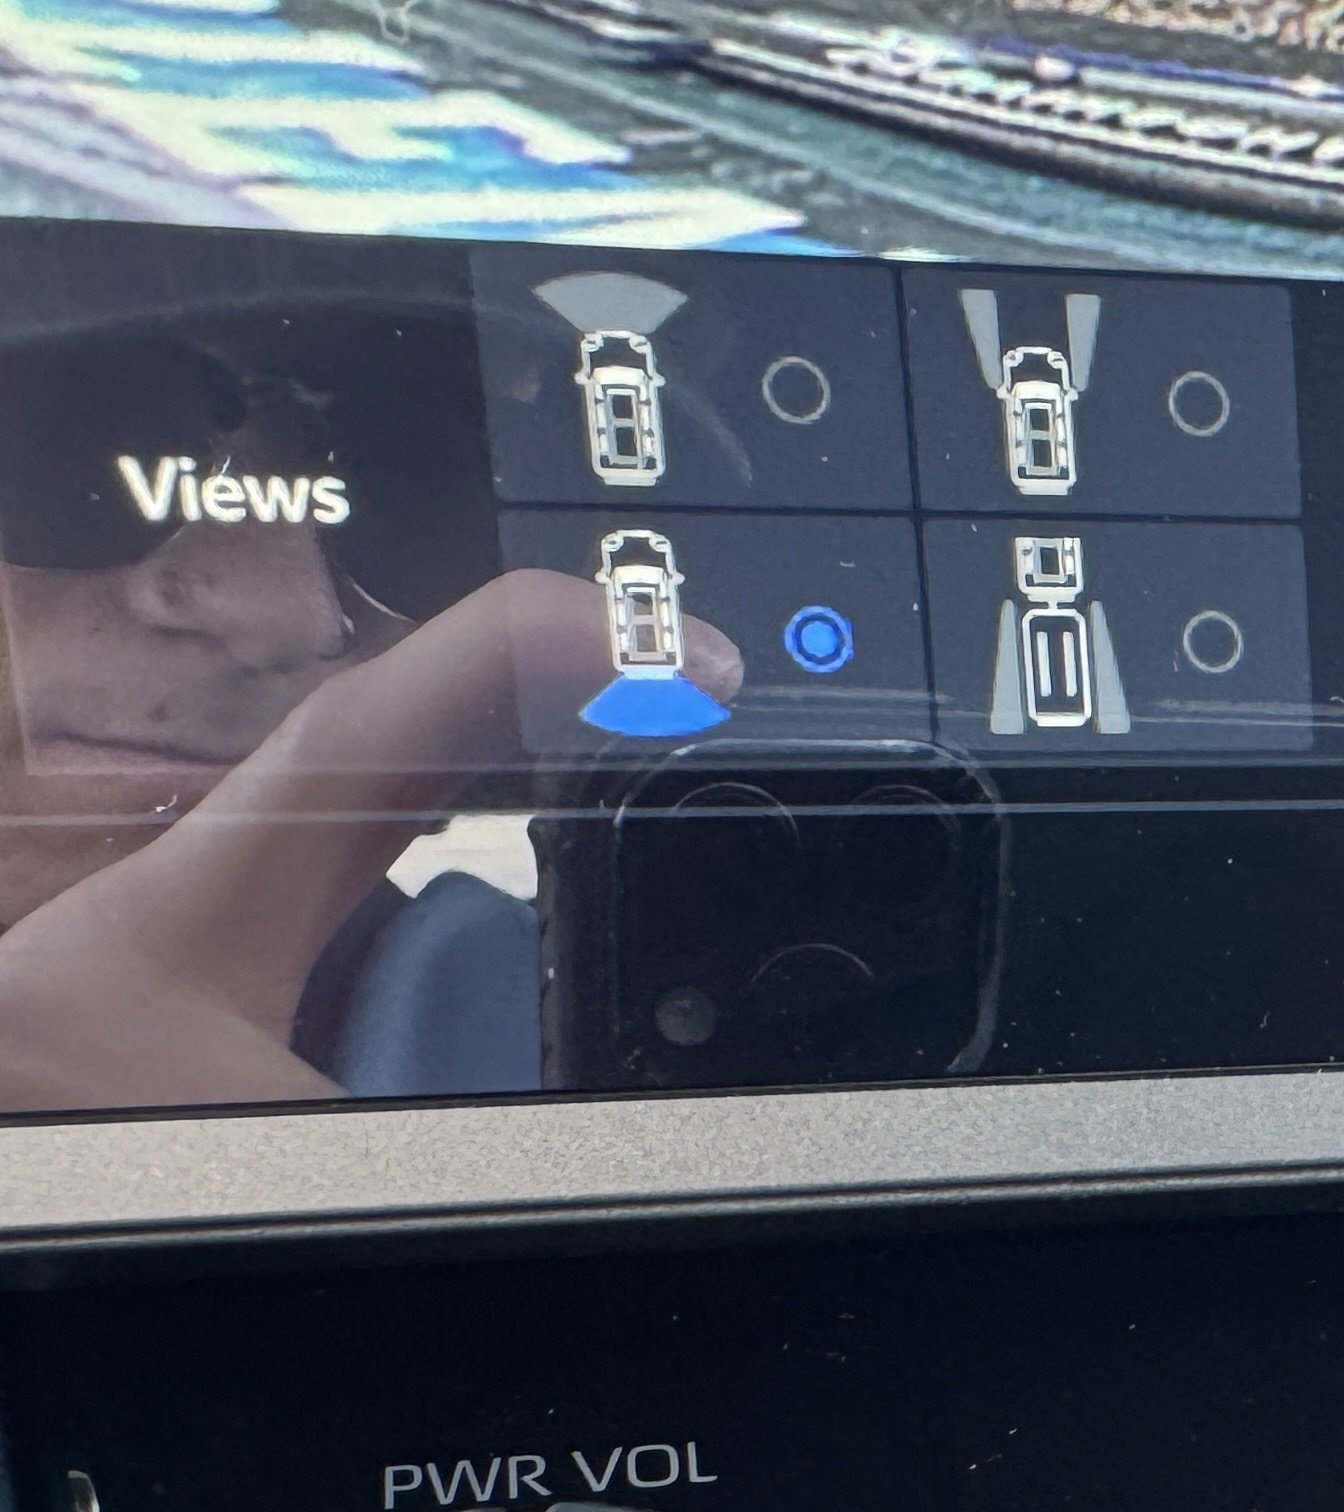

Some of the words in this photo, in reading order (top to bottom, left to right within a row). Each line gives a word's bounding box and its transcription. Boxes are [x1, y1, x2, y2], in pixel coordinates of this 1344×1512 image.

[116, 453, 352, 524] Views
[382, 1452, 552, 1511] PWR
[571, 1440, 718, 1492] VOL
